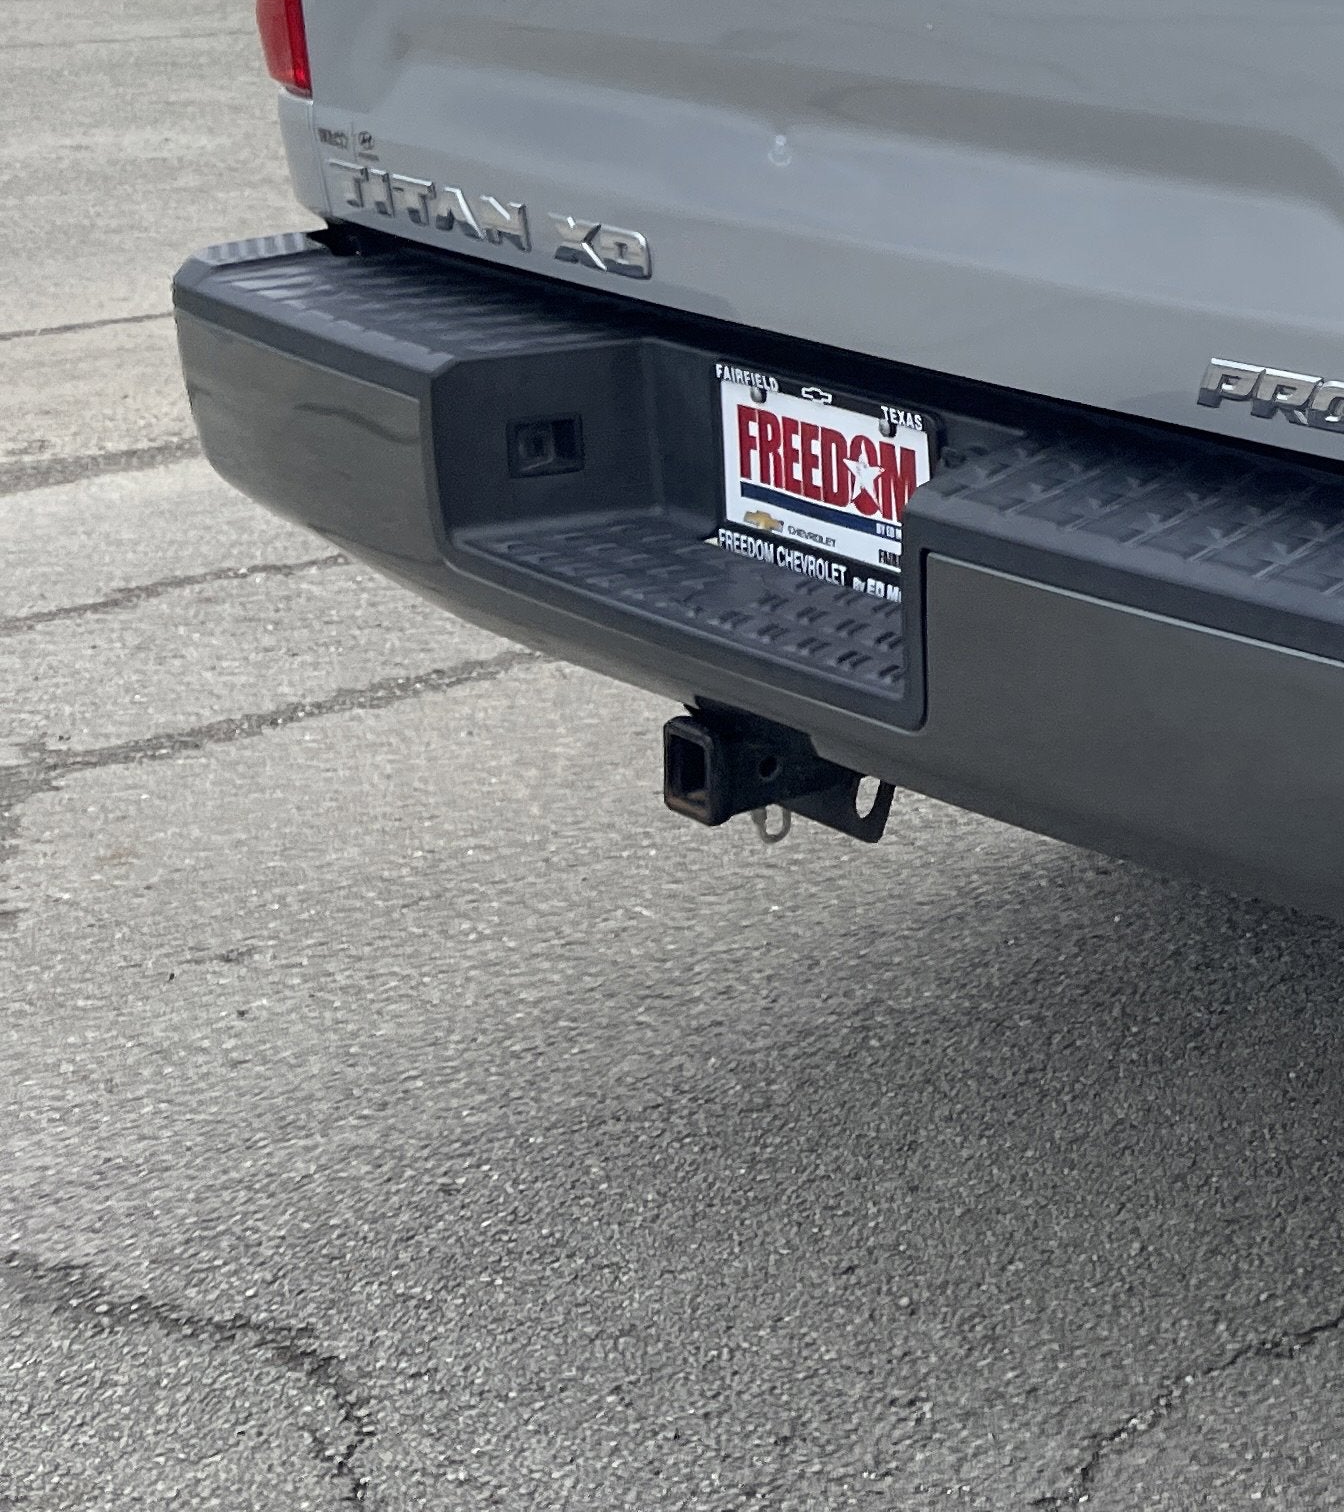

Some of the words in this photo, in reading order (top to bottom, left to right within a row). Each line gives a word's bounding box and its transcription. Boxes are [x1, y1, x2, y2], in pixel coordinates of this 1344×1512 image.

[326, 158, 531, 253] TITAN
[548, 212, 652, 281] XD
[715, 363, 780, 393] FAIRFIELD
[880, 405, 924, 432] TEXAS
[737, 403, 917, 522] FREEDOM
[718, 528, 775, 564] FREEDOM
[776, 545, 847, 587] CHEVROLET
[866, 577, 885, 599] ED
[787, 525, 836, 548] CHEVROLET
